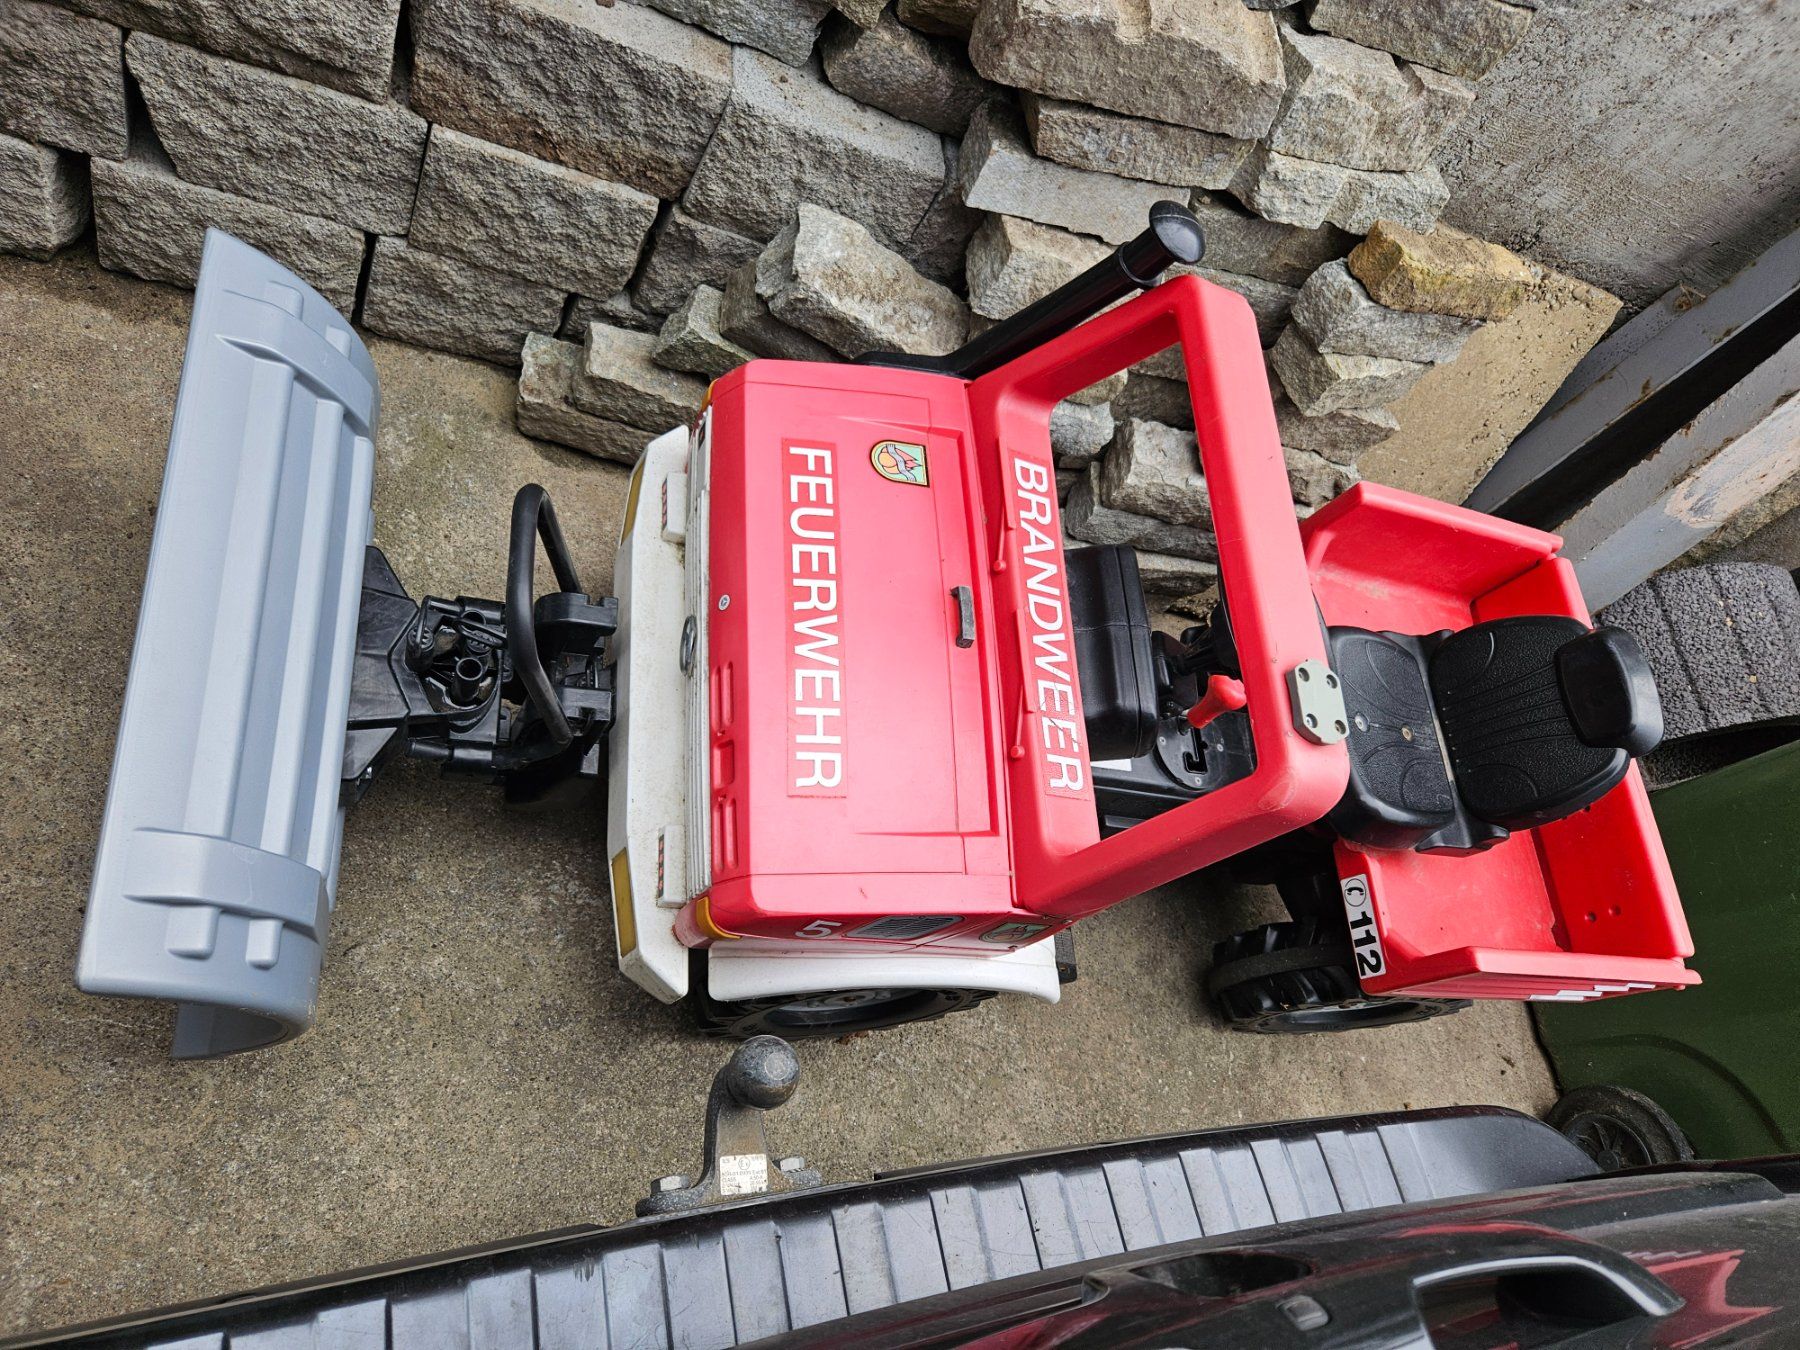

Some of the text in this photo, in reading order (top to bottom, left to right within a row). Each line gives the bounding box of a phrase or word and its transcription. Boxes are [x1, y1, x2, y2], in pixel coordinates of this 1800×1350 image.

[789, 446, 842, 788] FEUERWEHR
[1013, 457, 1084, 792] BRANDWEER
[795, 920, 842, 938] 5
[1349, 911, 1382, 977] 112
